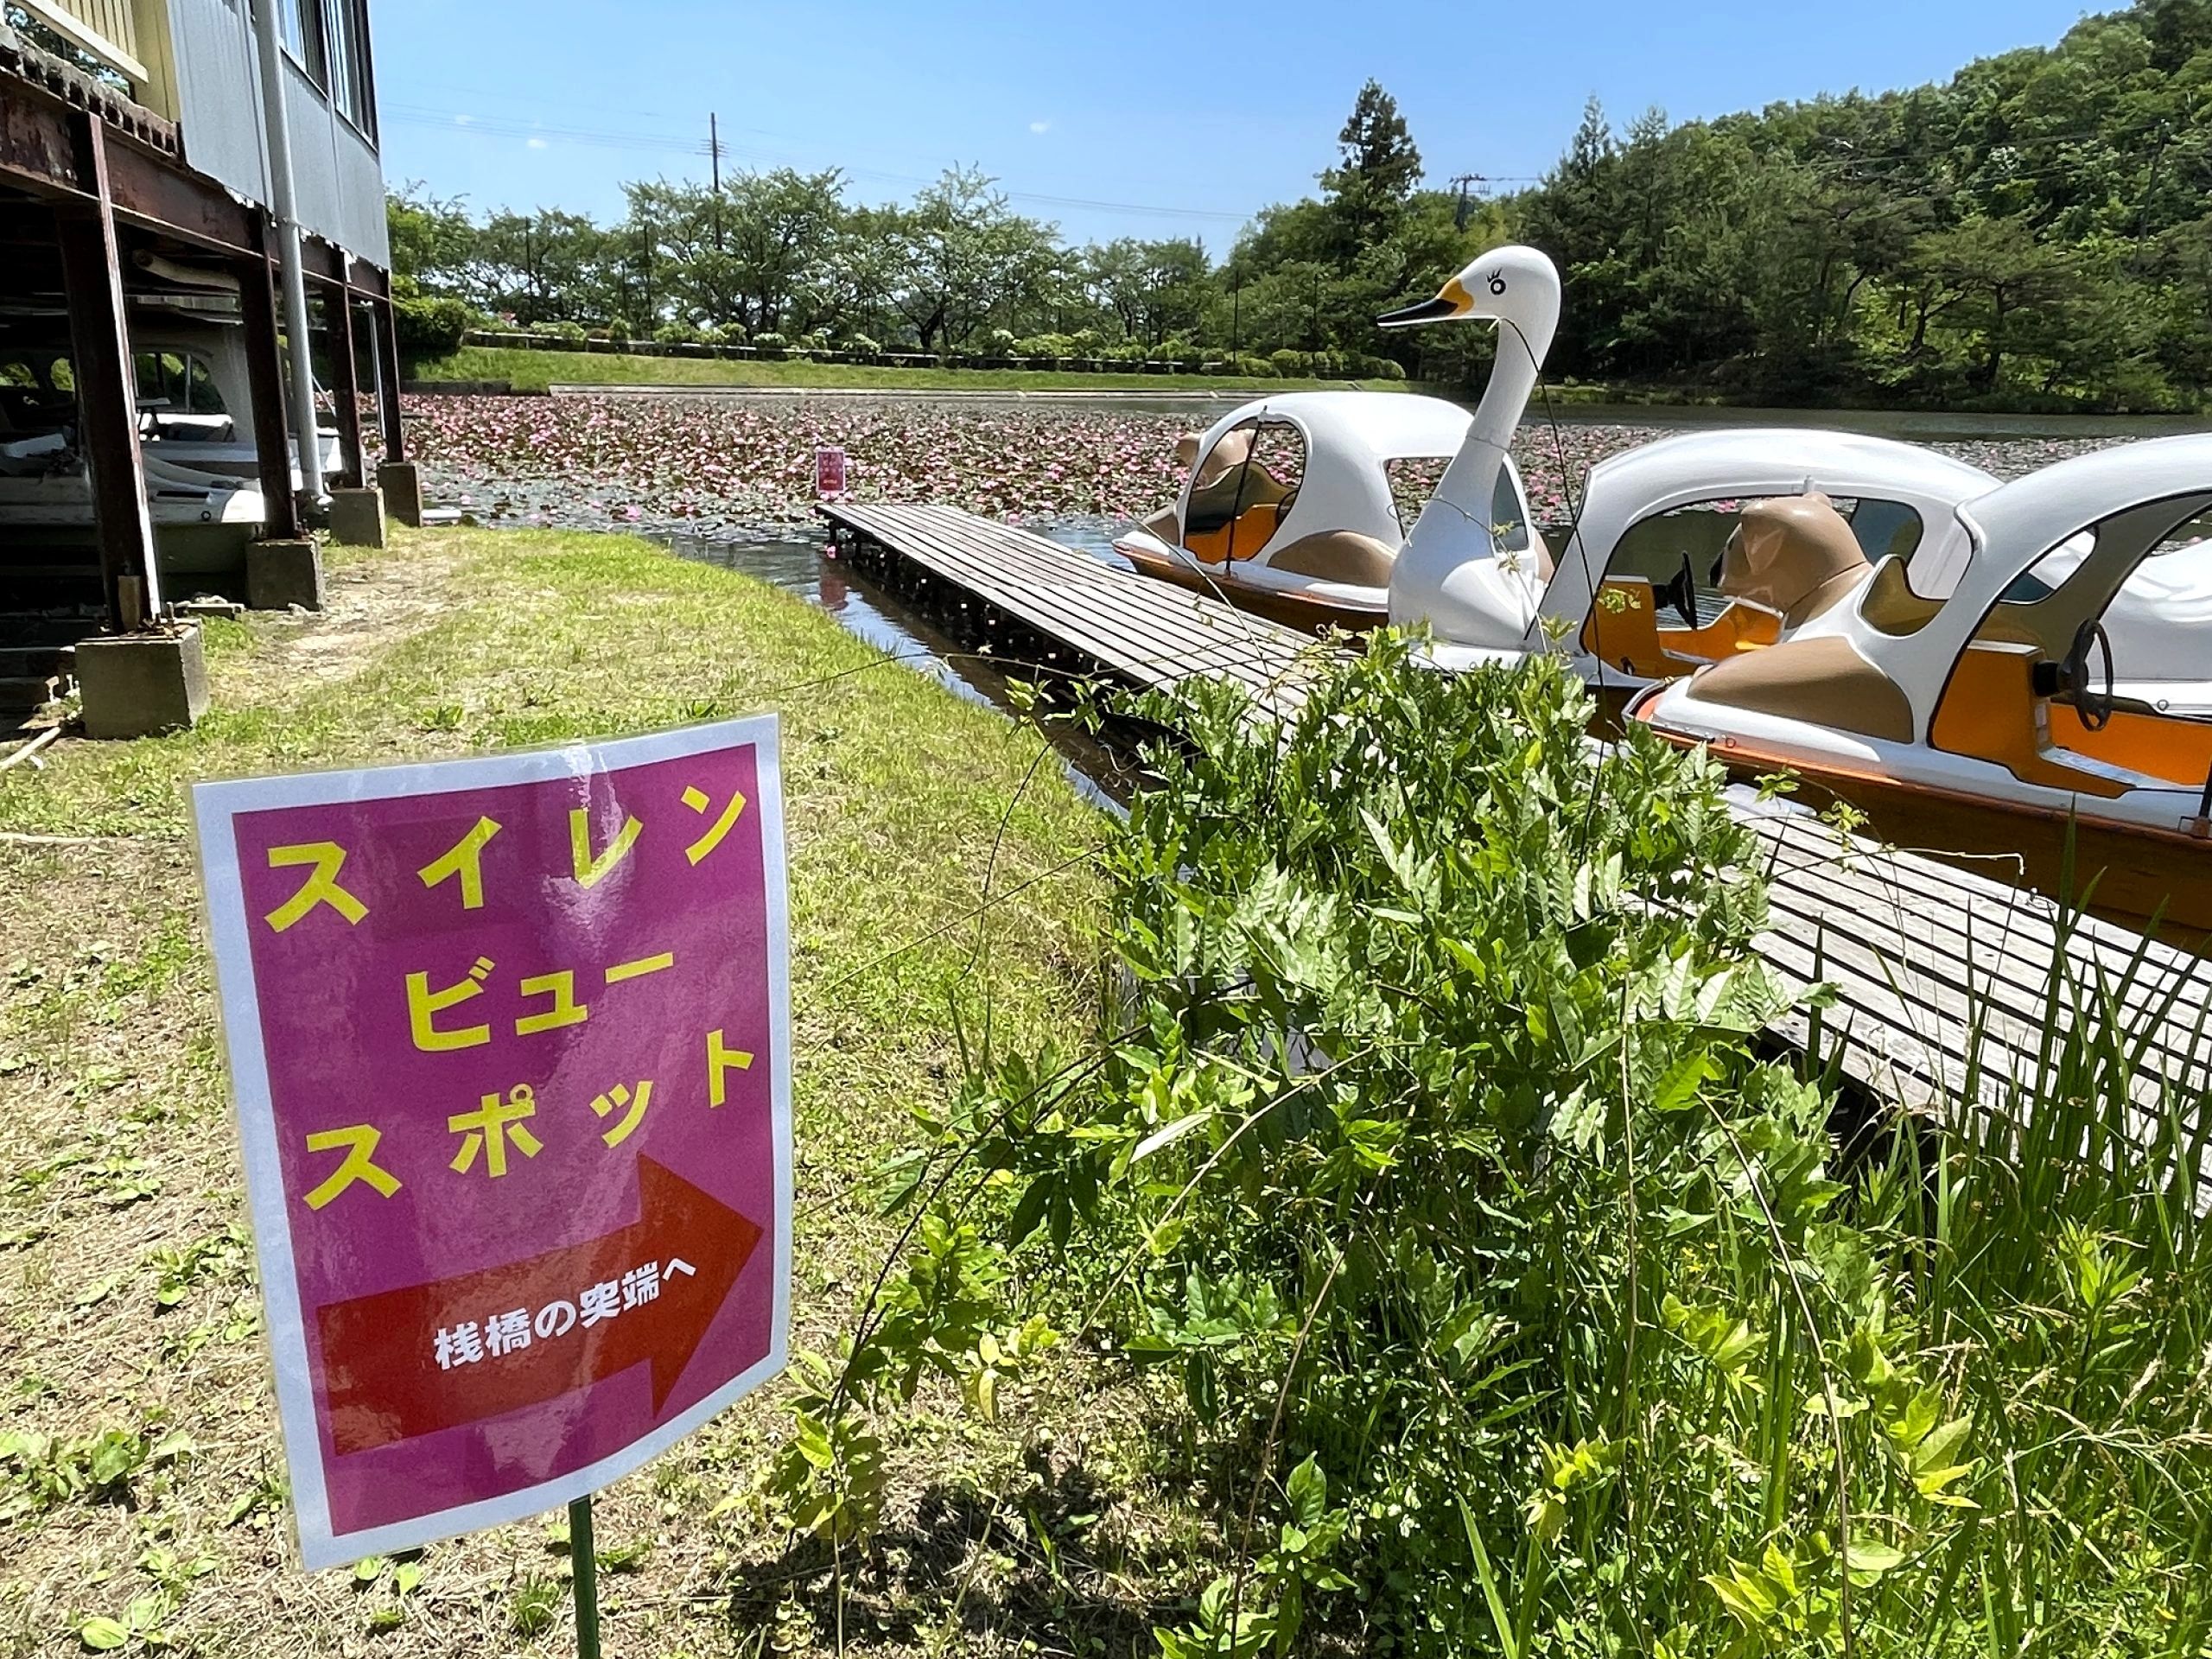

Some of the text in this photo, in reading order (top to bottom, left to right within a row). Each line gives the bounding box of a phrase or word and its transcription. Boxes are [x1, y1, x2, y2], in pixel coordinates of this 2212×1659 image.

[264, 785, 747, 932] スイレン
[405, 952, 673, 1052] ビュー
[303, 1029, 754, 1211] スポット
[434, 1257, 696, 1370] 桟橋の突端へ
